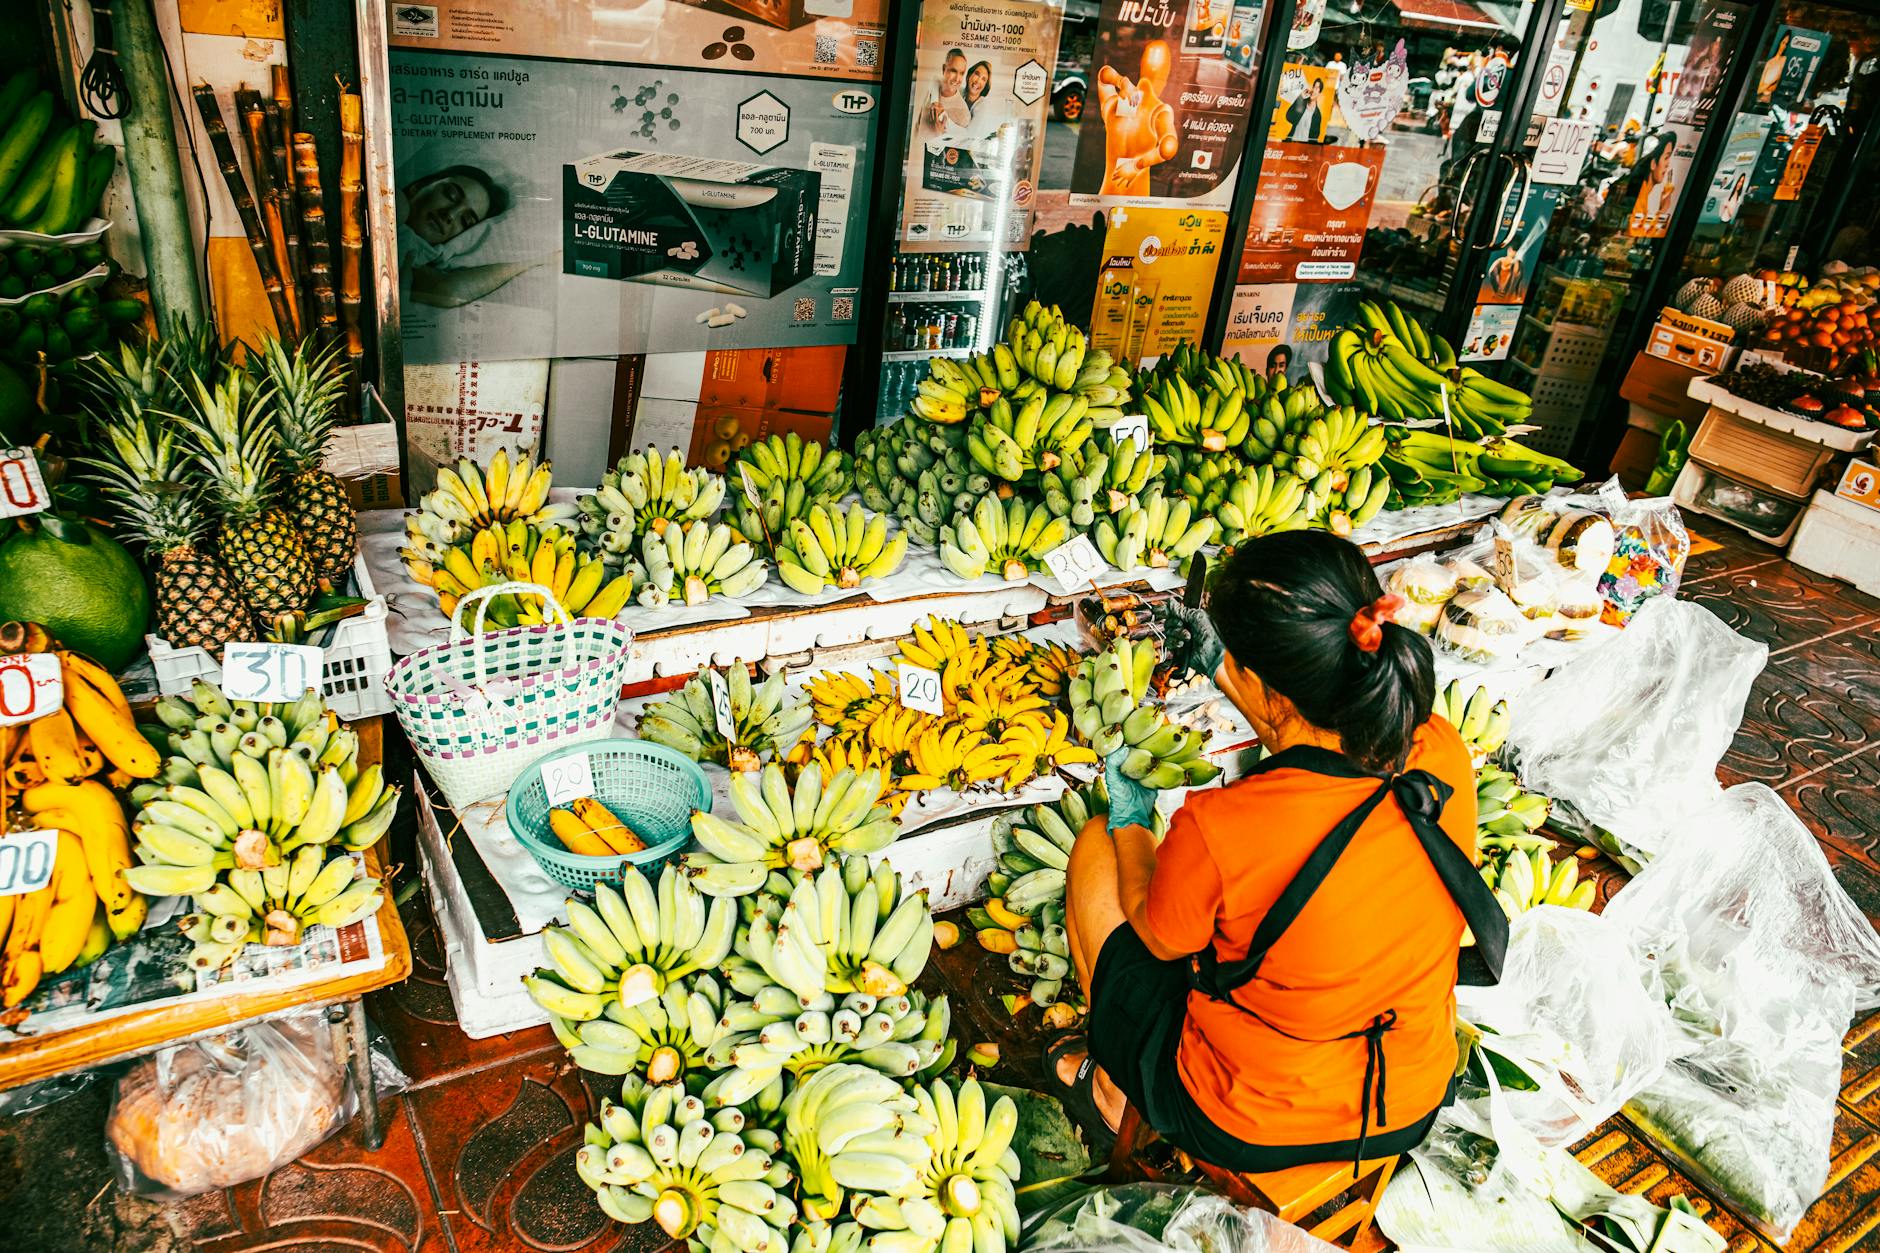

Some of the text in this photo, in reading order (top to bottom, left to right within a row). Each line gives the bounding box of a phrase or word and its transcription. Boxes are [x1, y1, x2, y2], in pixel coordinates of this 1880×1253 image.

[960, 14, 1024, 35] น้ำมันงา-1000
[961, 33, 1022, 45] SESAME OIL-1000
[460, 67, 489, 80] ฮาร์ด
[493, 69, 530, 85] แคปซูล
[393, 85, 504, 112] ล-กลูตามีน
[842, 95, 868, 109] THP
[397, 114, 474, 127] L-GLUTAMINE
[741, 113, 786, 123] แอล-กลูตามีน
[402, 129, 536, 141] DIETARY SUPPLEMENT PRODUCT
[1541, 122, 1590, 154] SLIDE
[813, 160, 850, 169] L-GLUTAMINE
[588, 175, 602, 183] THP
[702, 190, 737, 200] L-GLUTAMINE
[819, 192, 846, 200] LUTAMINE
[575, 223, 658, 246] L-GLUTAMINE
[817, 228, 840, 236] -กลูตามีน
[947, 225, 965, 235] THP
[1709, 332, 1729, 343] EET
[772, 352, 782, 384] DRAGON
[1, 459, 39, 508] 0
[1052, 543, 1093, 587] 30
[1498, 552, 1513, 577] 50
[226, 650, 307, 701] 30
[0, 665, 35, 716] 0
[907, 672, 937, 702] 20
[552, 762, 583, 798] 20
[0, 841, 50, 889] 00
